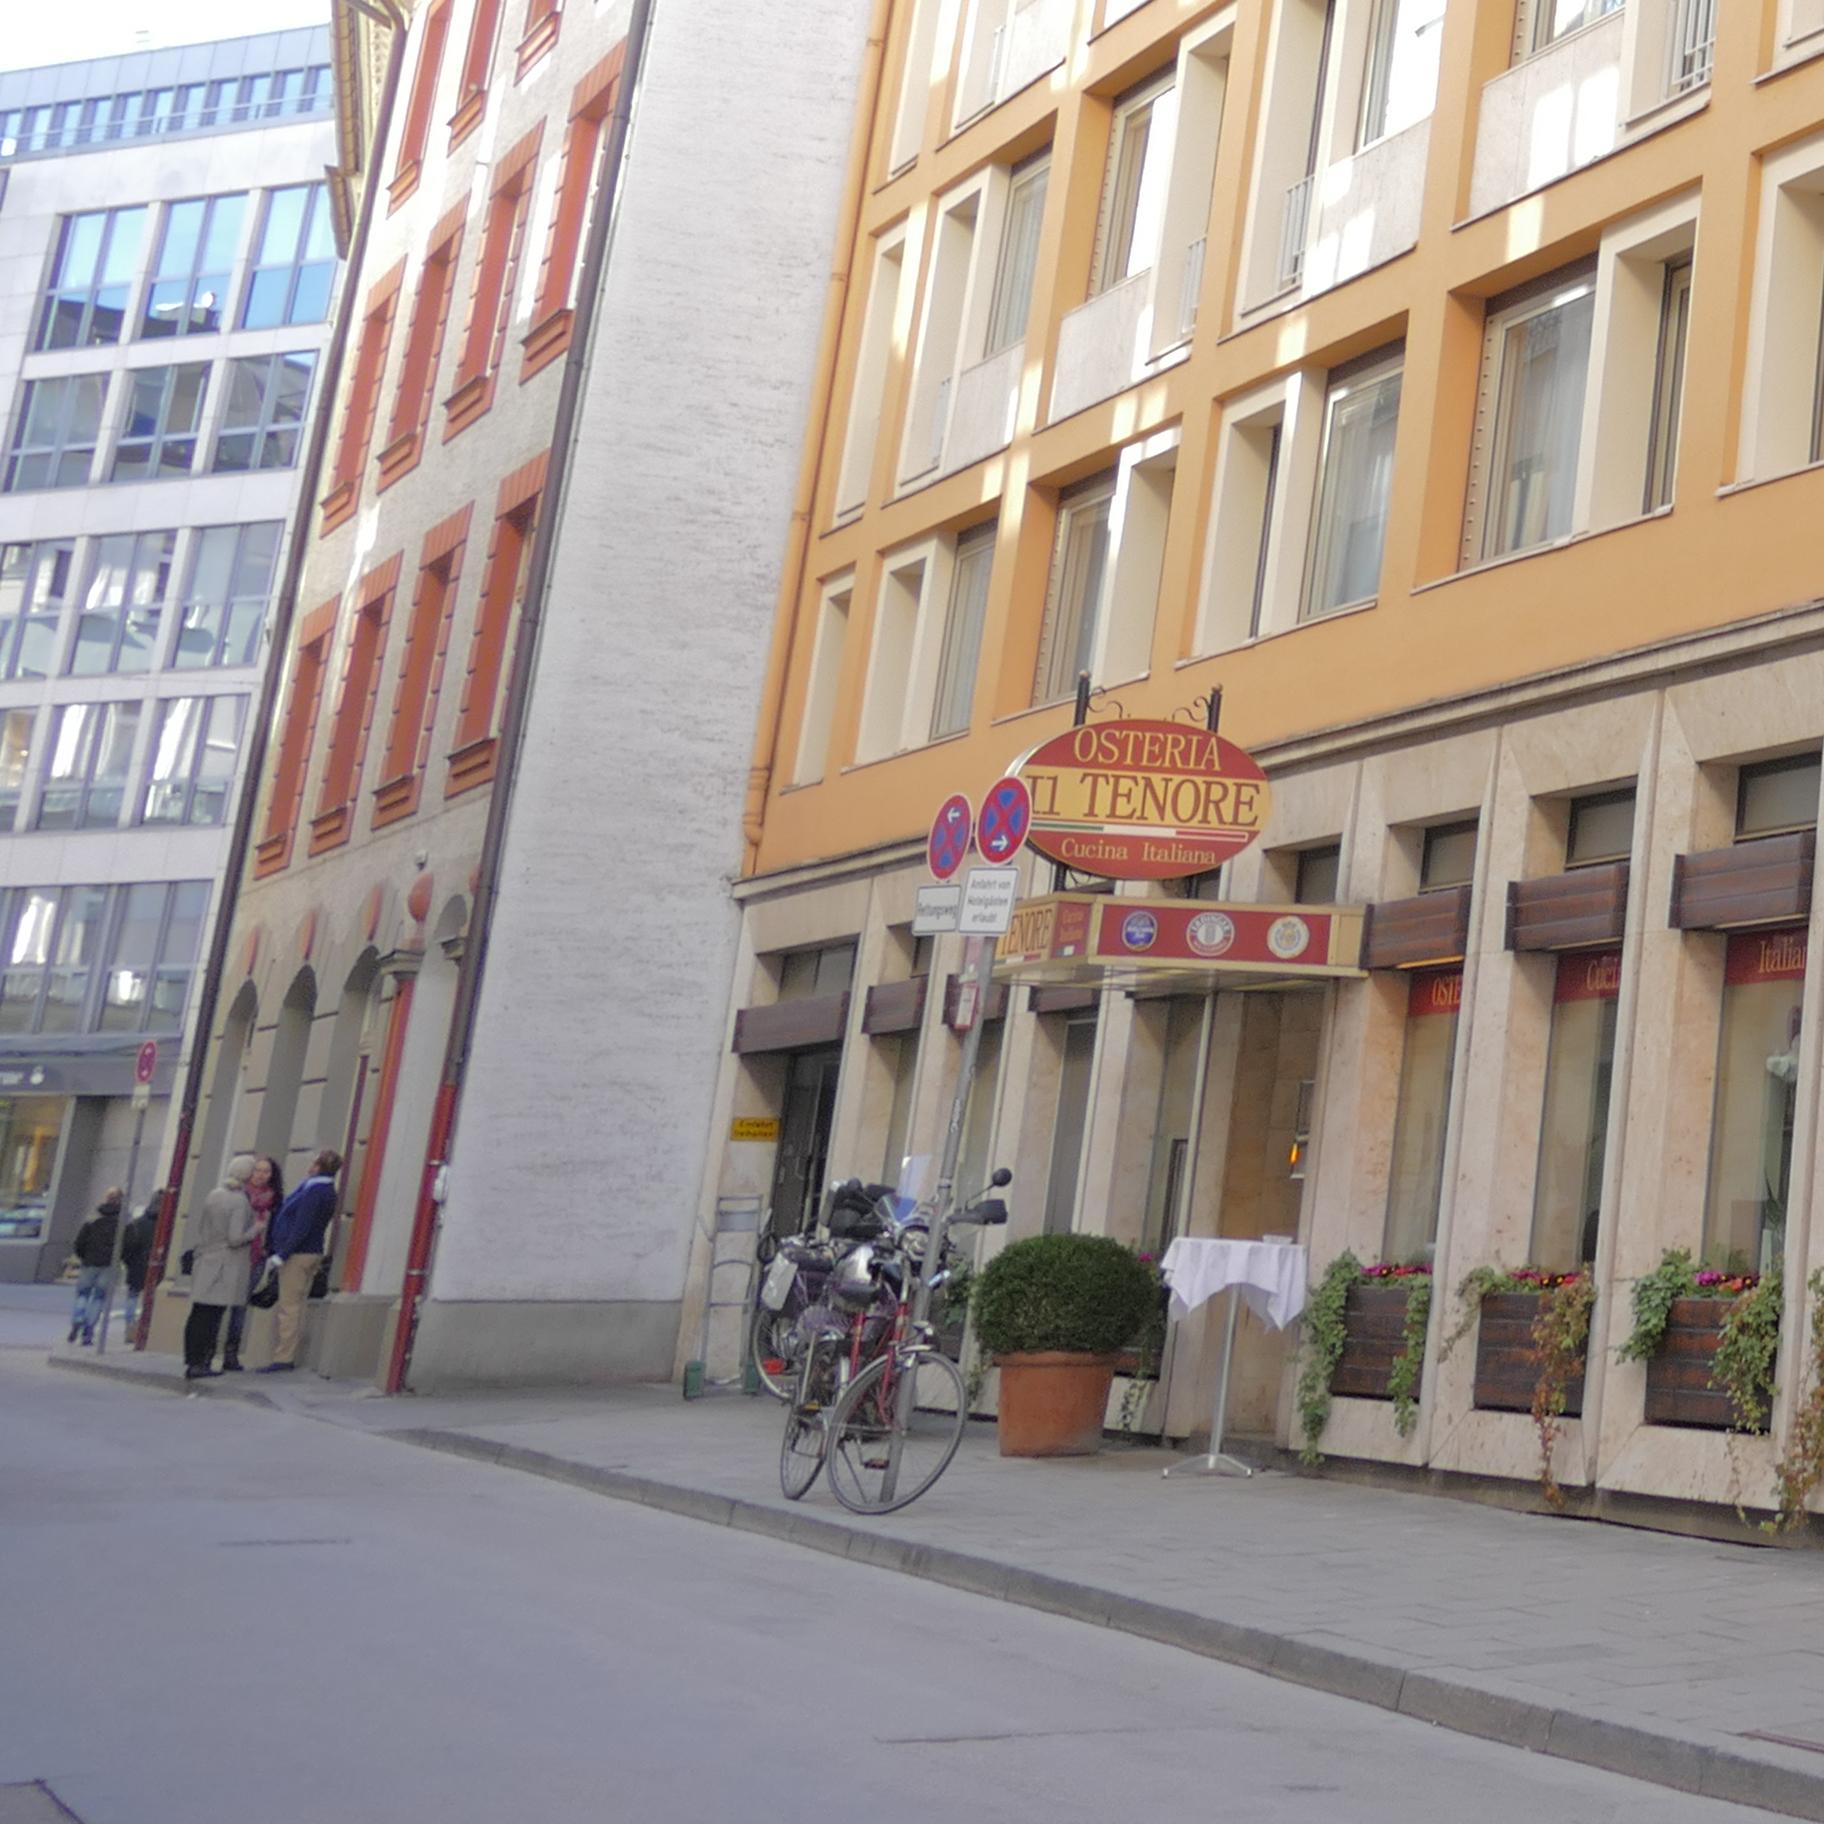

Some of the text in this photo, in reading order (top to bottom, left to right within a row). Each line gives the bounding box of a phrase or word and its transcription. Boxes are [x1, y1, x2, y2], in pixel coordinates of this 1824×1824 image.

[1073, 727, 1222, 772] OSTERIA
[1080, 773, 1261, 827] TENORE
[1061, 838, 1216, 865] Cucina Italiana
[1002, 907, 1053, 955] ENORE
